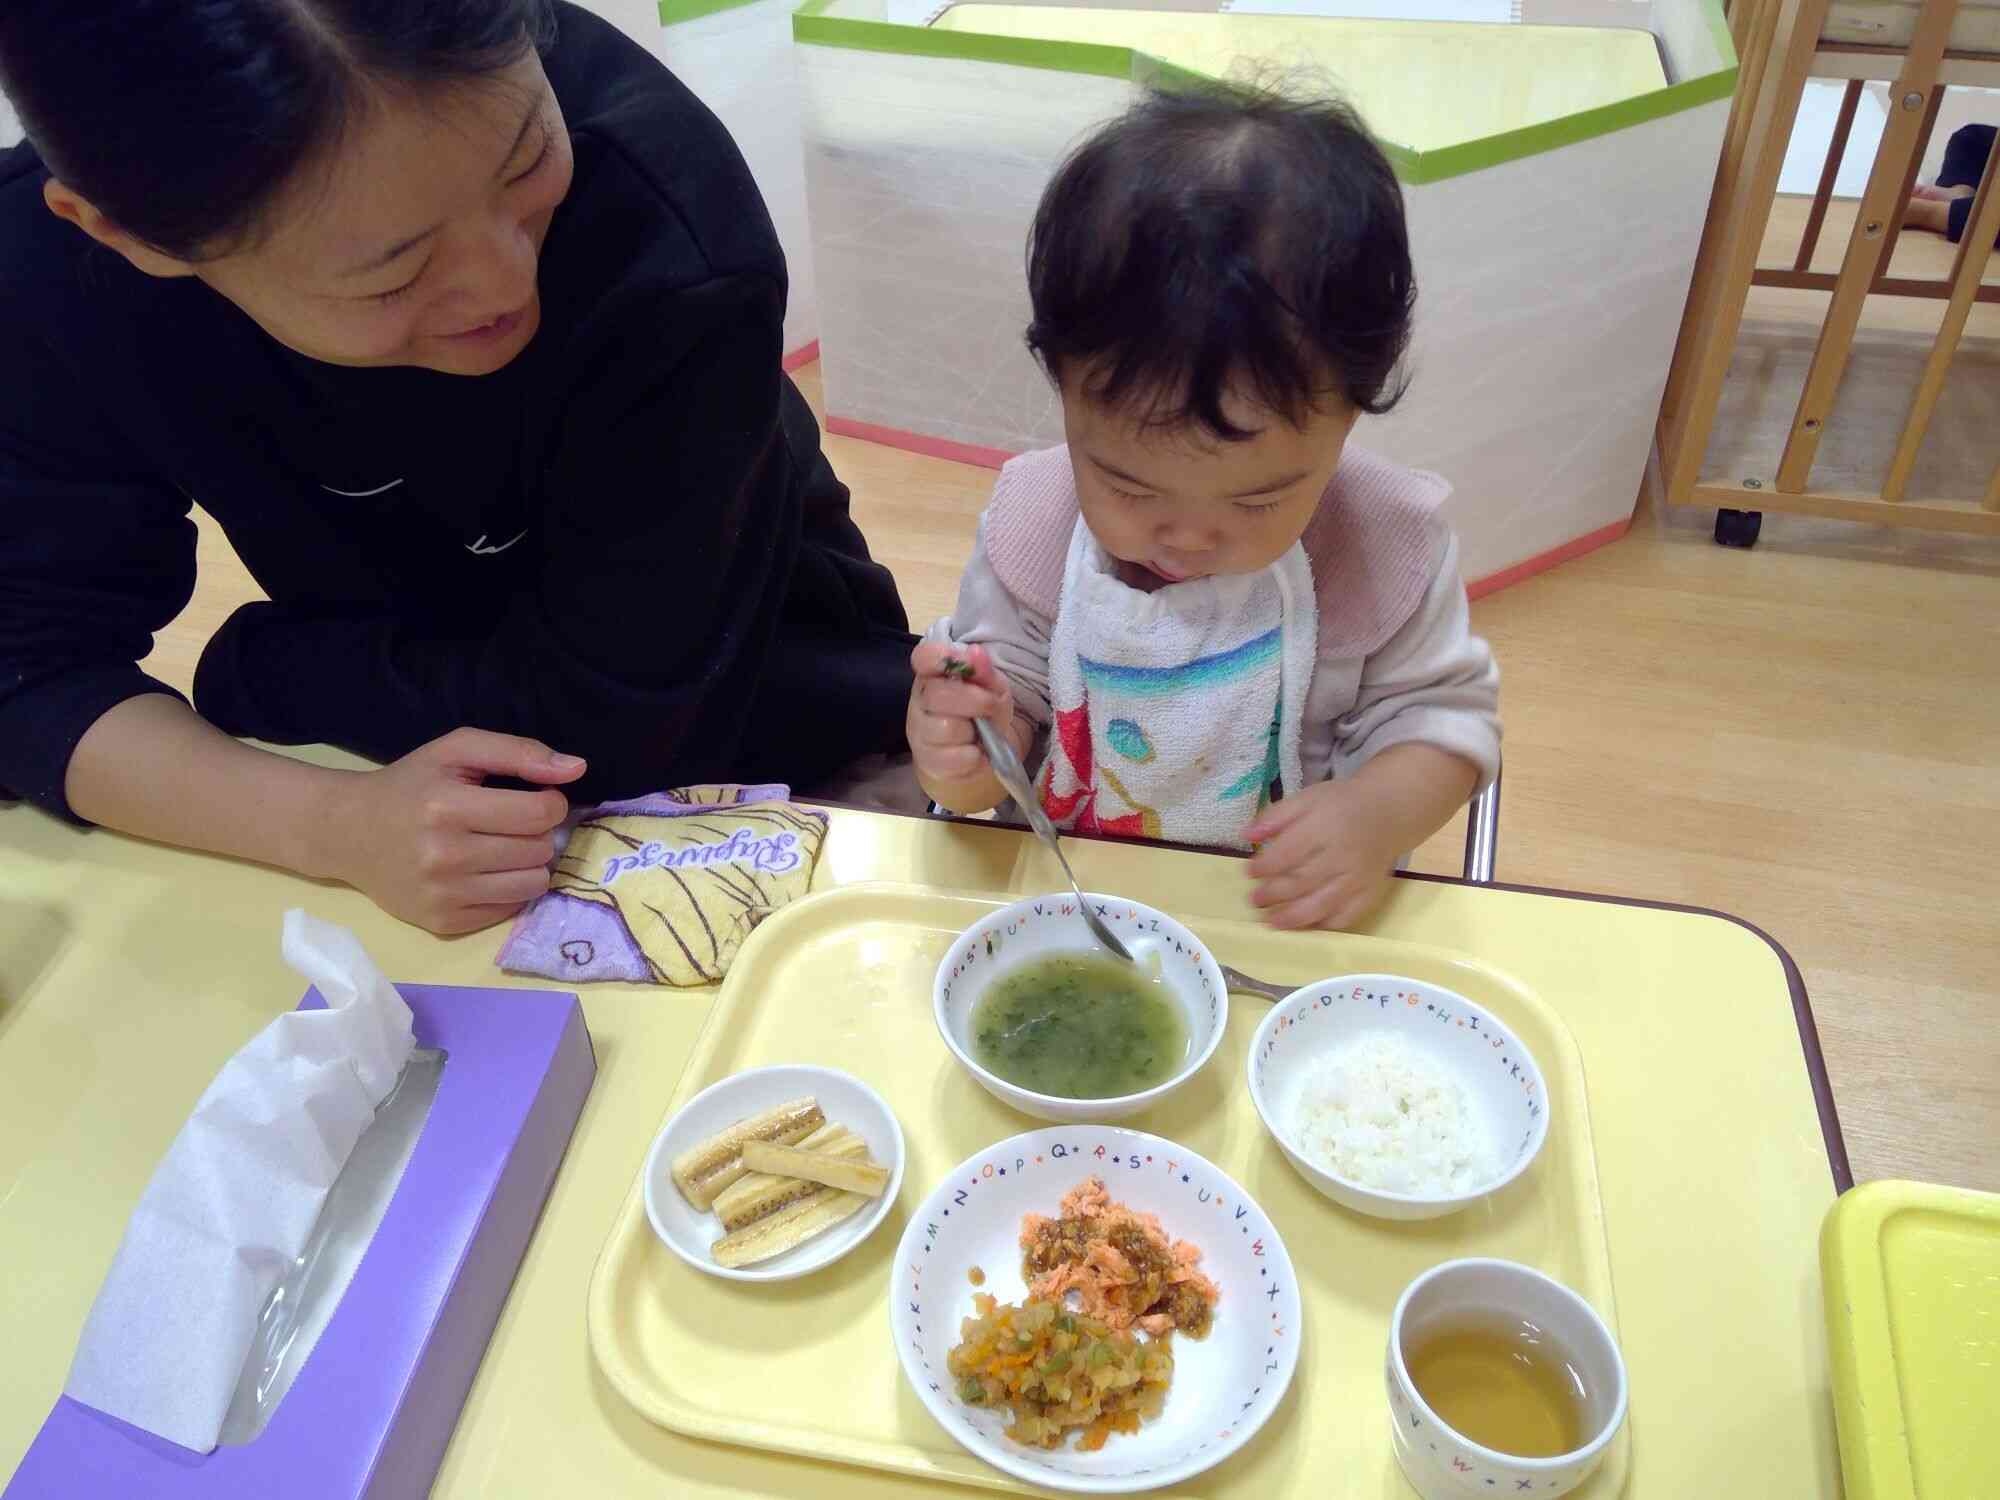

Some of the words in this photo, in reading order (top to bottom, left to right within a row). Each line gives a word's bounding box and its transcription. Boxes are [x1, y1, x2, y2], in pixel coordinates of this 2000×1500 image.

[603, 829, 799, 883] Rapunzel
[1034, 904, 1042, 915] V
[1061, 904, 1076, 916] W
[1096, 905, 1107, 917] X
[1151, 920, 1160, 932] Z
[1175, 941, 1183, 953] A
[1321, 995, 1332, 1006] D
[1351, 987, 1364, 1000] E
[1380, 995, 1391, 1008] F
[1407, 993, 1419, 1005] G
[1436, 1009, 1450, 1023] H
[1470, 1016, 1479, 1029] I
[1510, 1063, 1520, 1079] K
[1051, 1143, 1068, 1158] Q
[1016, 1159, 1025, 1174] P
[1130, 1155, 1141, 1169] S
[1167, 1160, 1178, 1174] T
[982, 1164, 993, 1178] O
[954, 1190, 968, 1206] N
[1198, 1188, 1210, 1202] U
[1235, 1204, 1247, 1219] V
[927, 1223, 938, 1240] M
[1252, 1239, 1265, 1256] W
[1267, 1282, 1280, 1302] X
[910, 1302, 920, 1313] K
[1265, 1360, 1278, 1375] Z
[1411, 1413, 1420, 1427] V
[1454, 1456, 1472, 1471] W
[1516, 1480, 1532, 1490] X
